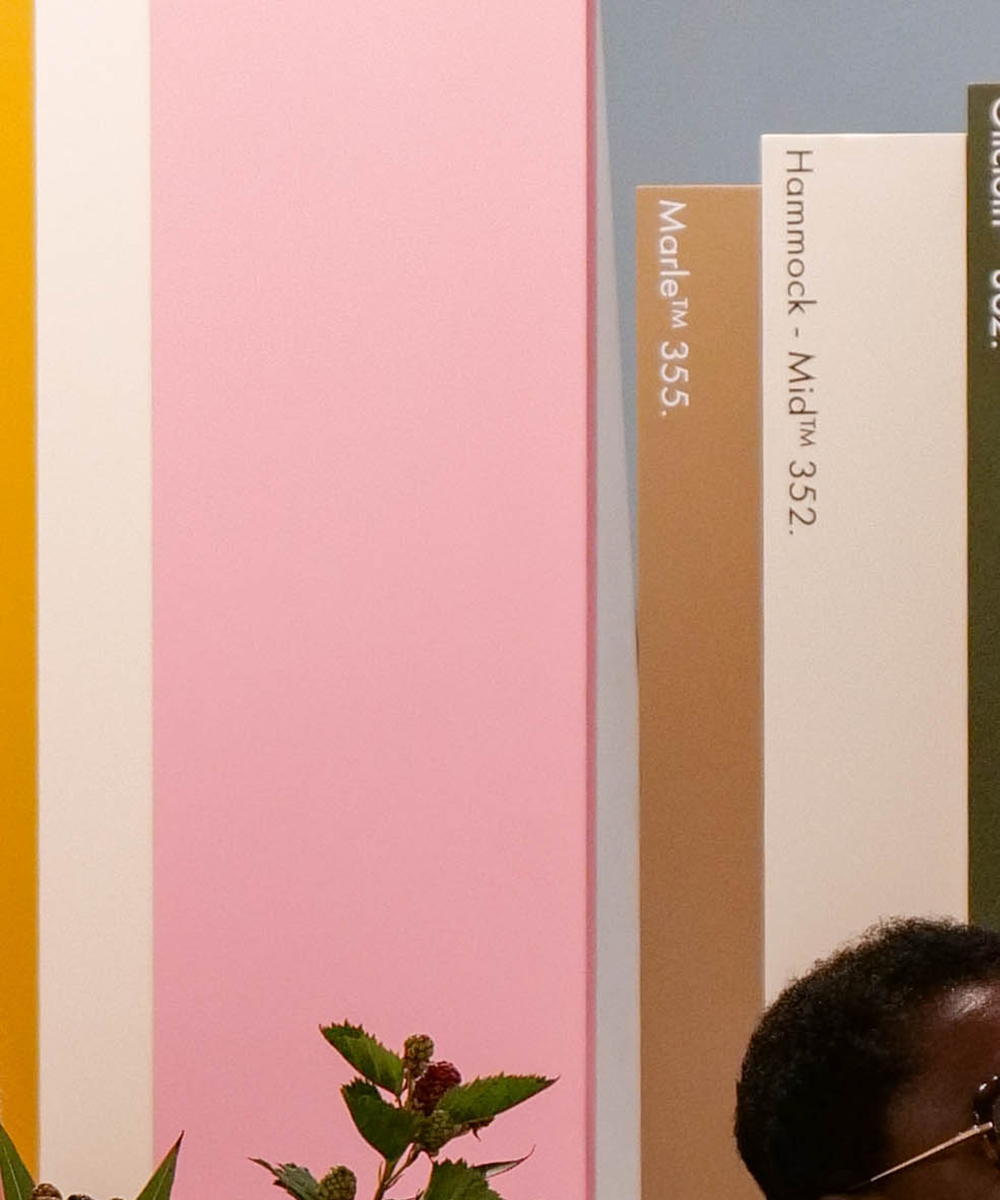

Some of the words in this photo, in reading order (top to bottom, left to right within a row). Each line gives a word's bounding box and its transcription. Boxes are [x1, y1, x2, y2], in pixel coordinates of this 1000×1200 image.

[786, 150, 817, 316] Hammock
[794, 327, 800, 338] -
[660, 341, 690, 417] 355.
[788, 460, 818, 536] 352.
